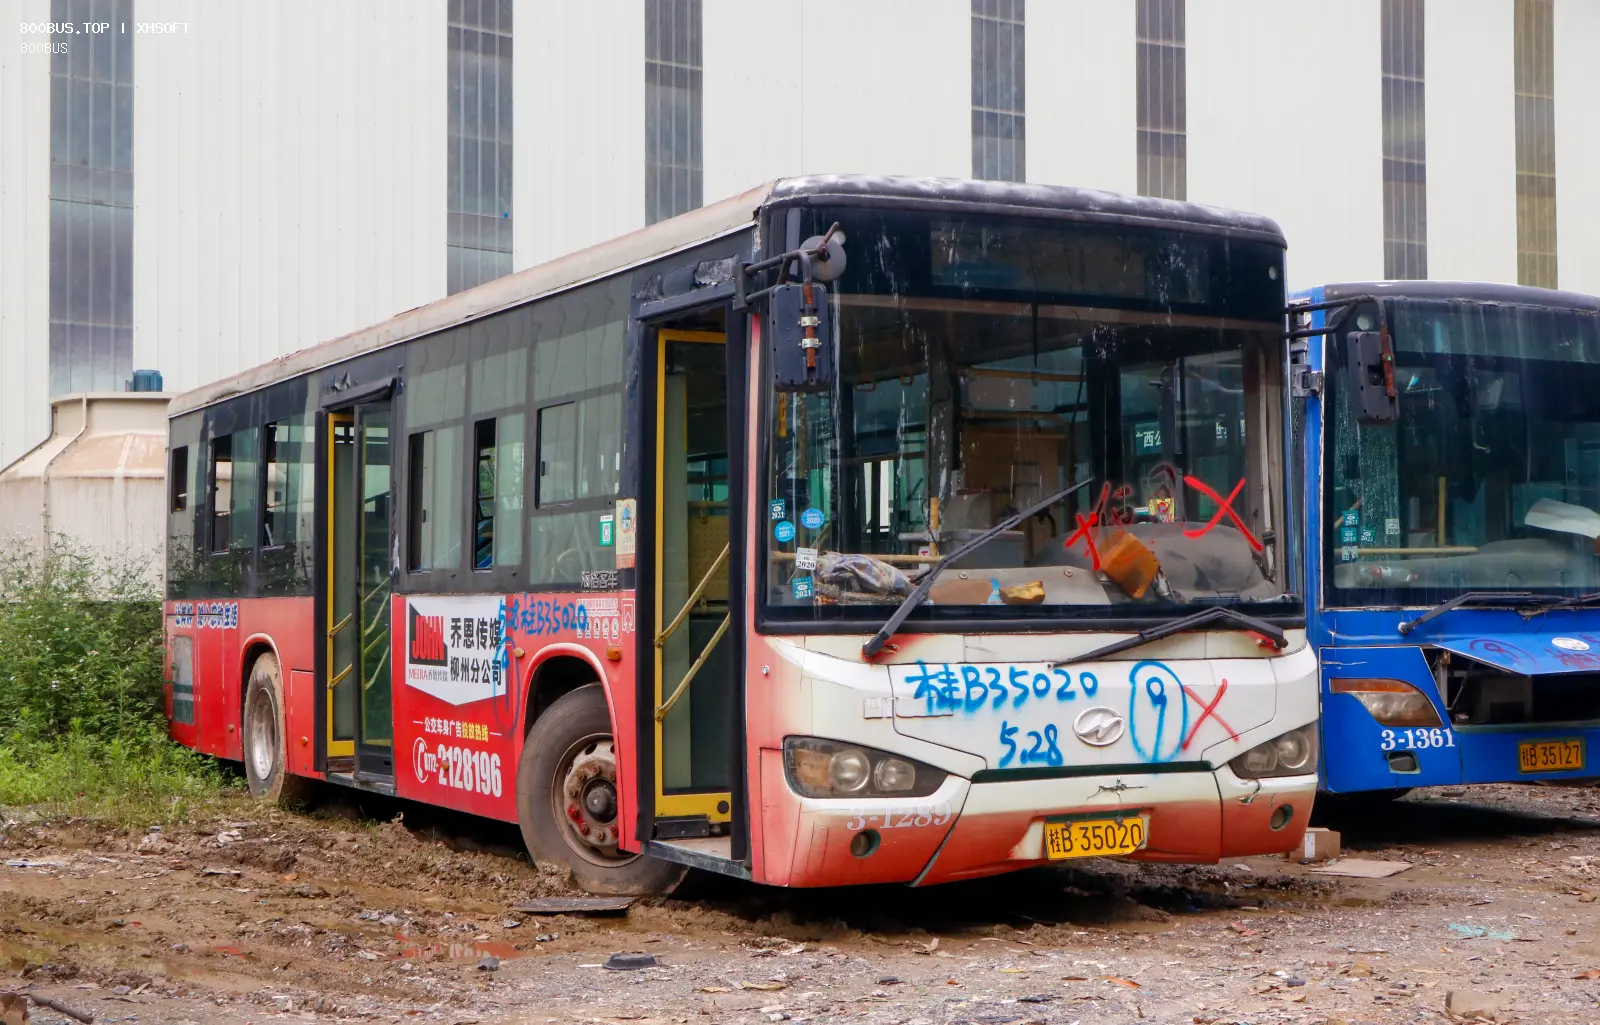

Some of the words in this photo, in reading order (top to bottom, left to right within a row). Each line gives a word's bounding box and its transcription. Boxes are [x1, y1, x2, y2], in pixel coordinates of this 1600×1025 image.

[797, 561, 815, 569] 2020
[795, 590, 812, 599] 2021
[450, 617, 501, 650] 乔恩传媒
[450, 656, 501, 685] 柳州分公司
[905, 660, 1098, 715] 桂B35020
[1380, 727, 1456, 751] 3-1361
[846, 800, 952, 831] 3-1289
